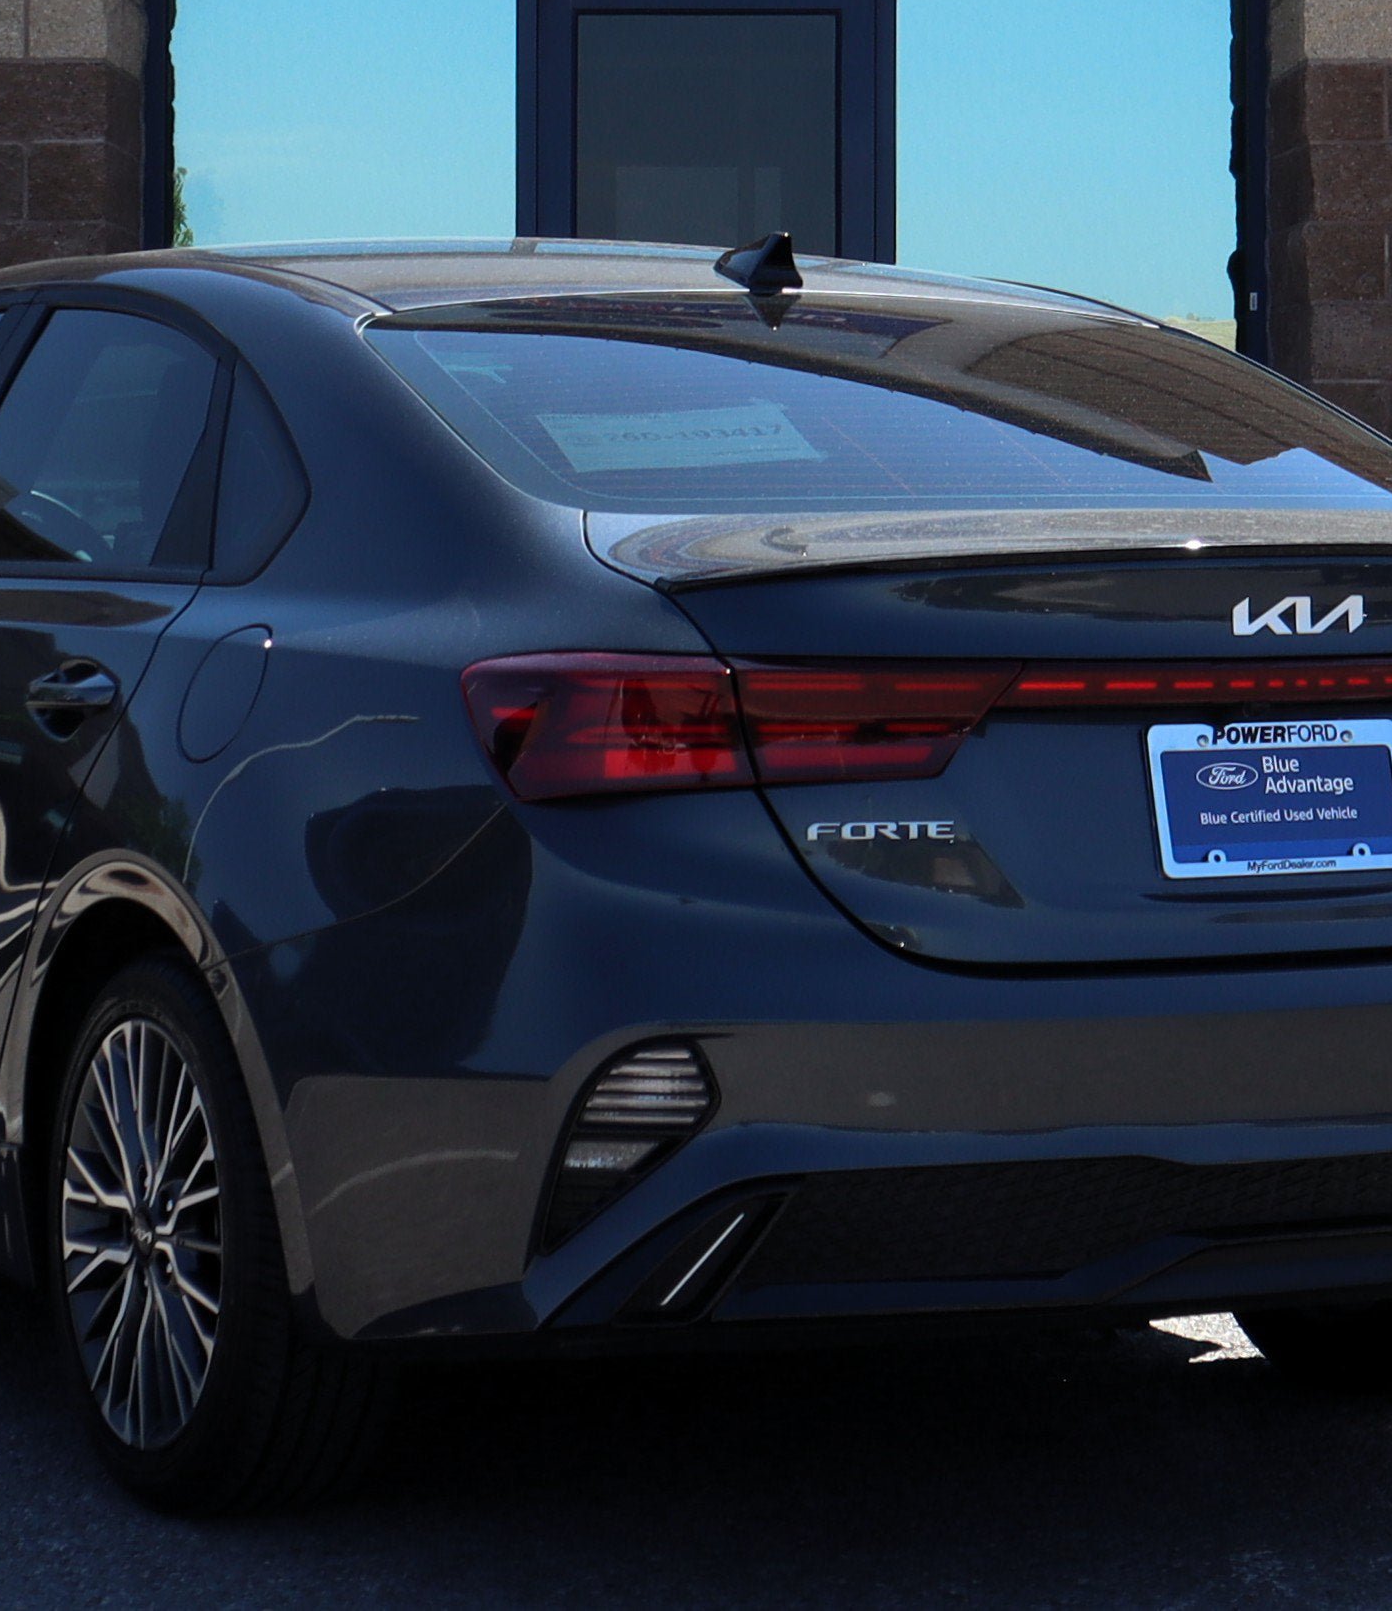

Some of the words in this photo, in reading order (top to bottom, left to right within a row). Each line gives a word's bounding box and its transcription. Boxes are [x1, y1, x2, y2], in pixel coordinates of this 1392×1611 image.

[1232, 594, 1364, 636] KIA
[1211, 723, 1338, 746] POWERFORD
[1262, 755, 1300, 774] Blue
[1208, 766, 1247, 785] Ford
[1265, 775, 1355, 796] Advantage
[1200, 811, 1228, 826] Blue
[1230, 809, 1282, 824] Certified
[1283, 808, 1314, 822] Used
[1316, 806, 1358, 821] Vehicle
[807, 820, 955, 841] FORTE
[1247, 858, 1337, 874] MyFordDealer.com
